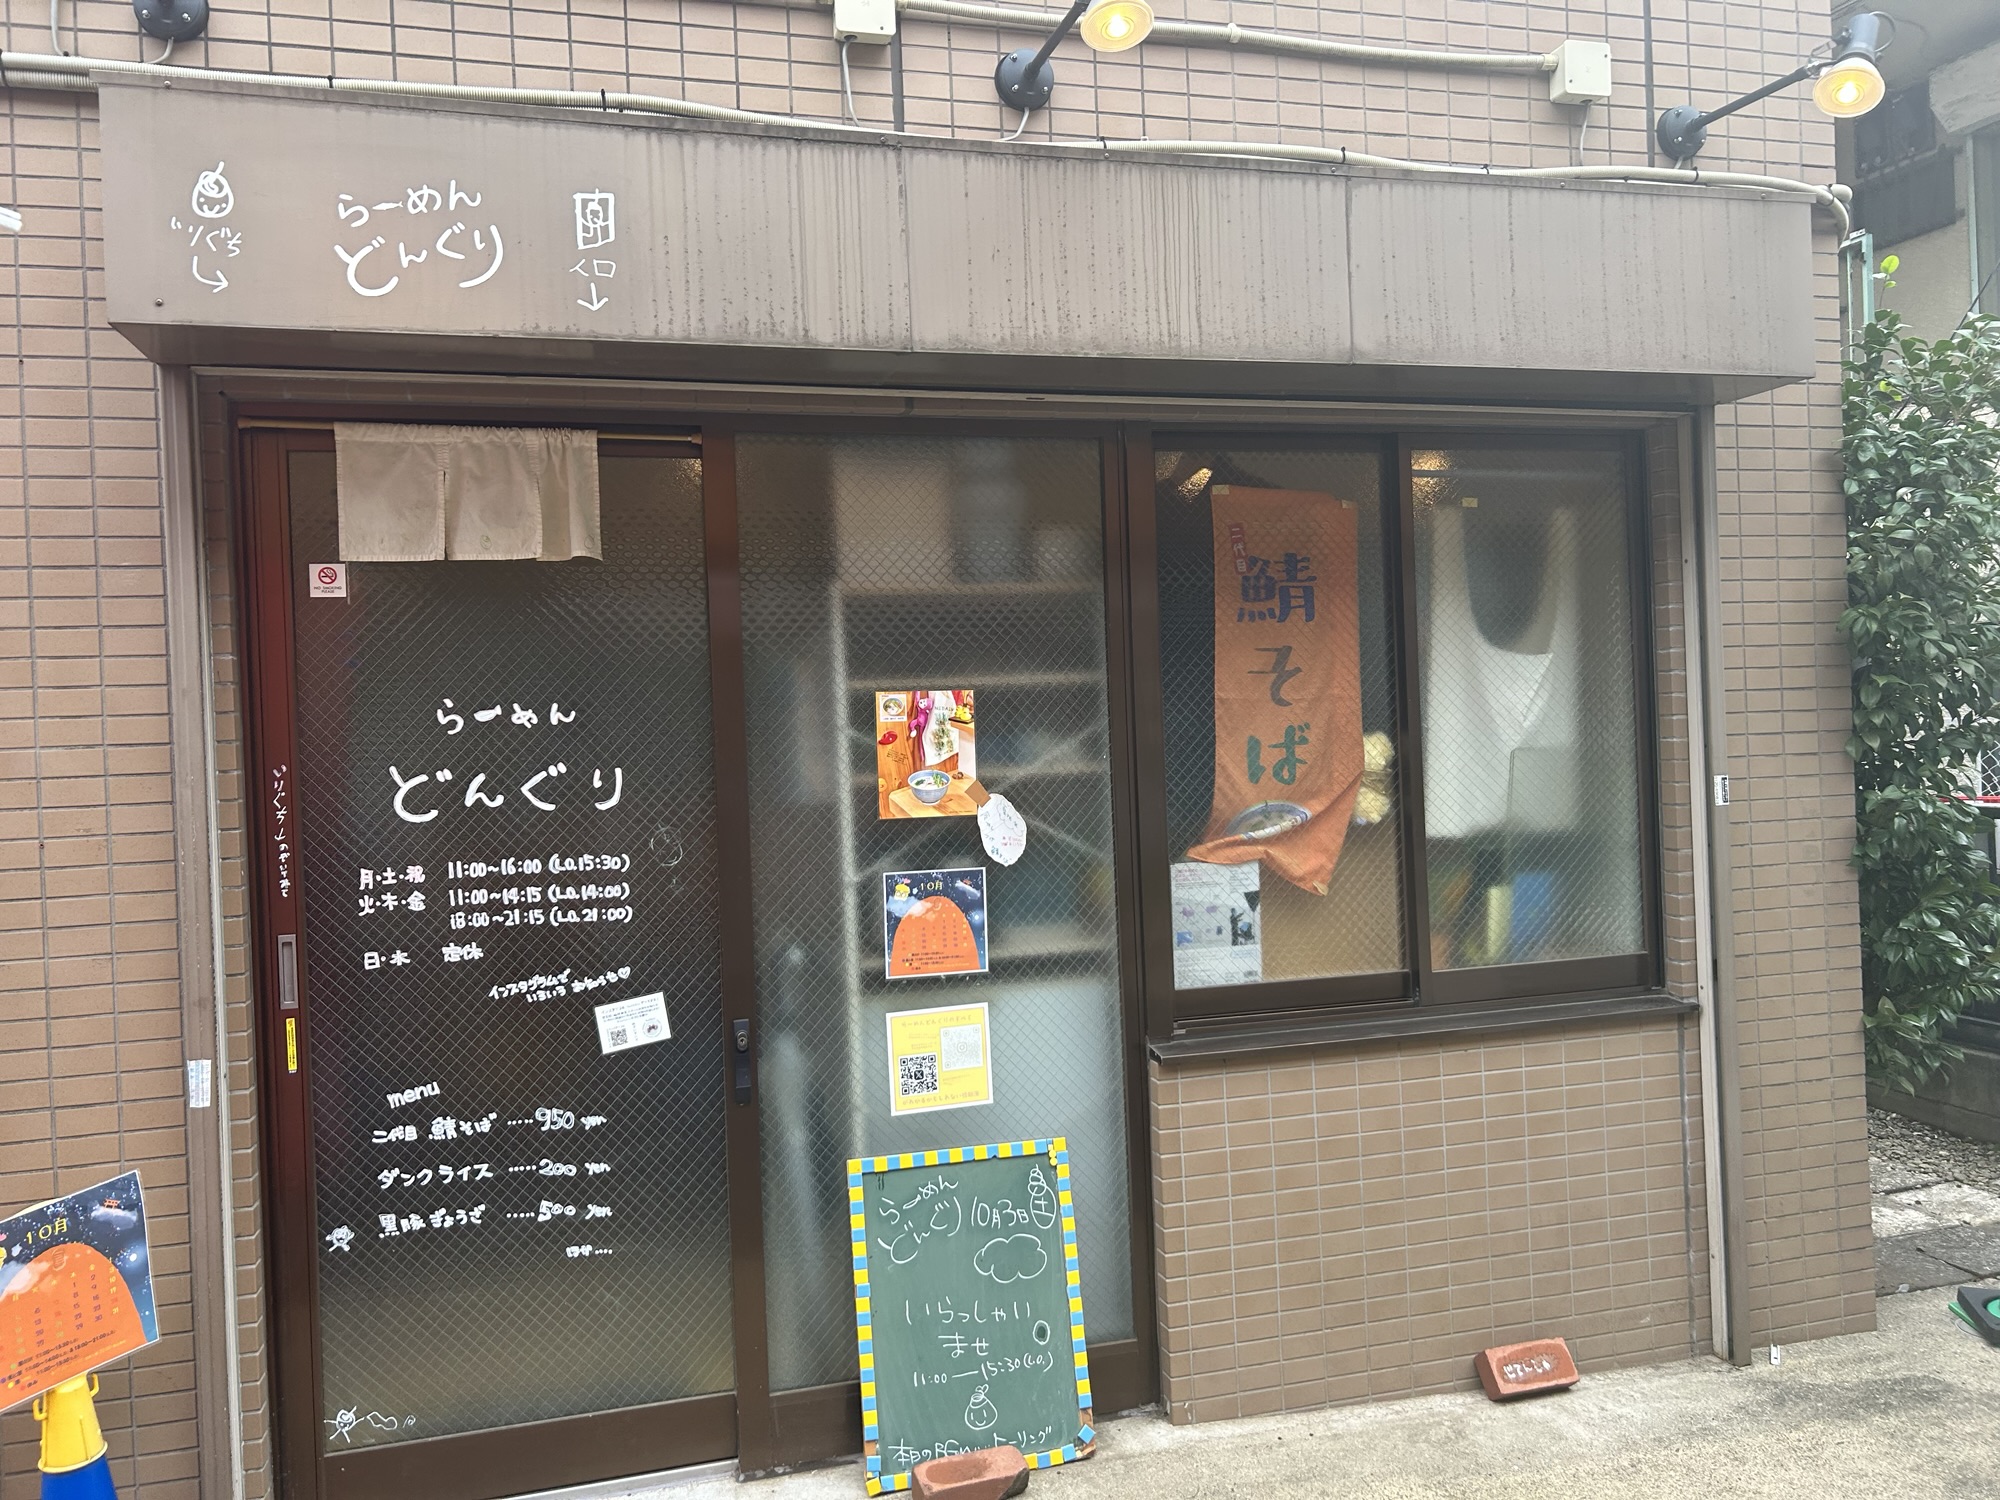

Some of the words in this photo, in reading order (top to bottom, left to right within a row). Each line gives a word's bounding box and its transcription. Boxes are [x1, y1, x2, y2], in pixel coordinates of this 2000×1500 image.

[338, 180, 481, 227] らーめん
[171, 216, 242, 257] いりぐち
[333, 222, 503, 296] どんぐり
[1231, 527, 1247, 573] 二代目
[1237, 553, 1317, 786] 鯖そば
[437, 699, 575, 734] らーめん
[273, 764, 288, 824] いりぐち
[390, 763, 622, 822] どんぐり
[920, 880, 943, 891] 10月
[364, 949, 411, 970] 日・水
[441, 942, 484, 962] 定休
[488, 968, 571, 1000] インスタグラムで
[526, 985, 567, 1003] いろいろ
[387, 1081, 440, 1108] menu
[372, 1125, 418, 1143] 二代目
[428, 1112, 498, 1140] 鯖そば
[535, 1107, 575, 1131] 950
[581, 1115, 607, 1130] yen
[378, 1163, 494, 1189] ダンクライス
[538, 1158, 577, 1177] 200
[584, 1162, 611, 1176] yen
[537, 1200, 577, 1222] 500
[584, 1203, 613, 1220] yen
[879, 1174, 960, 1225] らーめん
[26, 1217, 68, 1245] 10月
[877, 1195, 962, 1264] どんぐり
[971, 1195, 1029, 1230] 10月3日
[905, 1296, 1031, 1325] いらっしゃい
[938, 1332, 990, 1358] ませ
